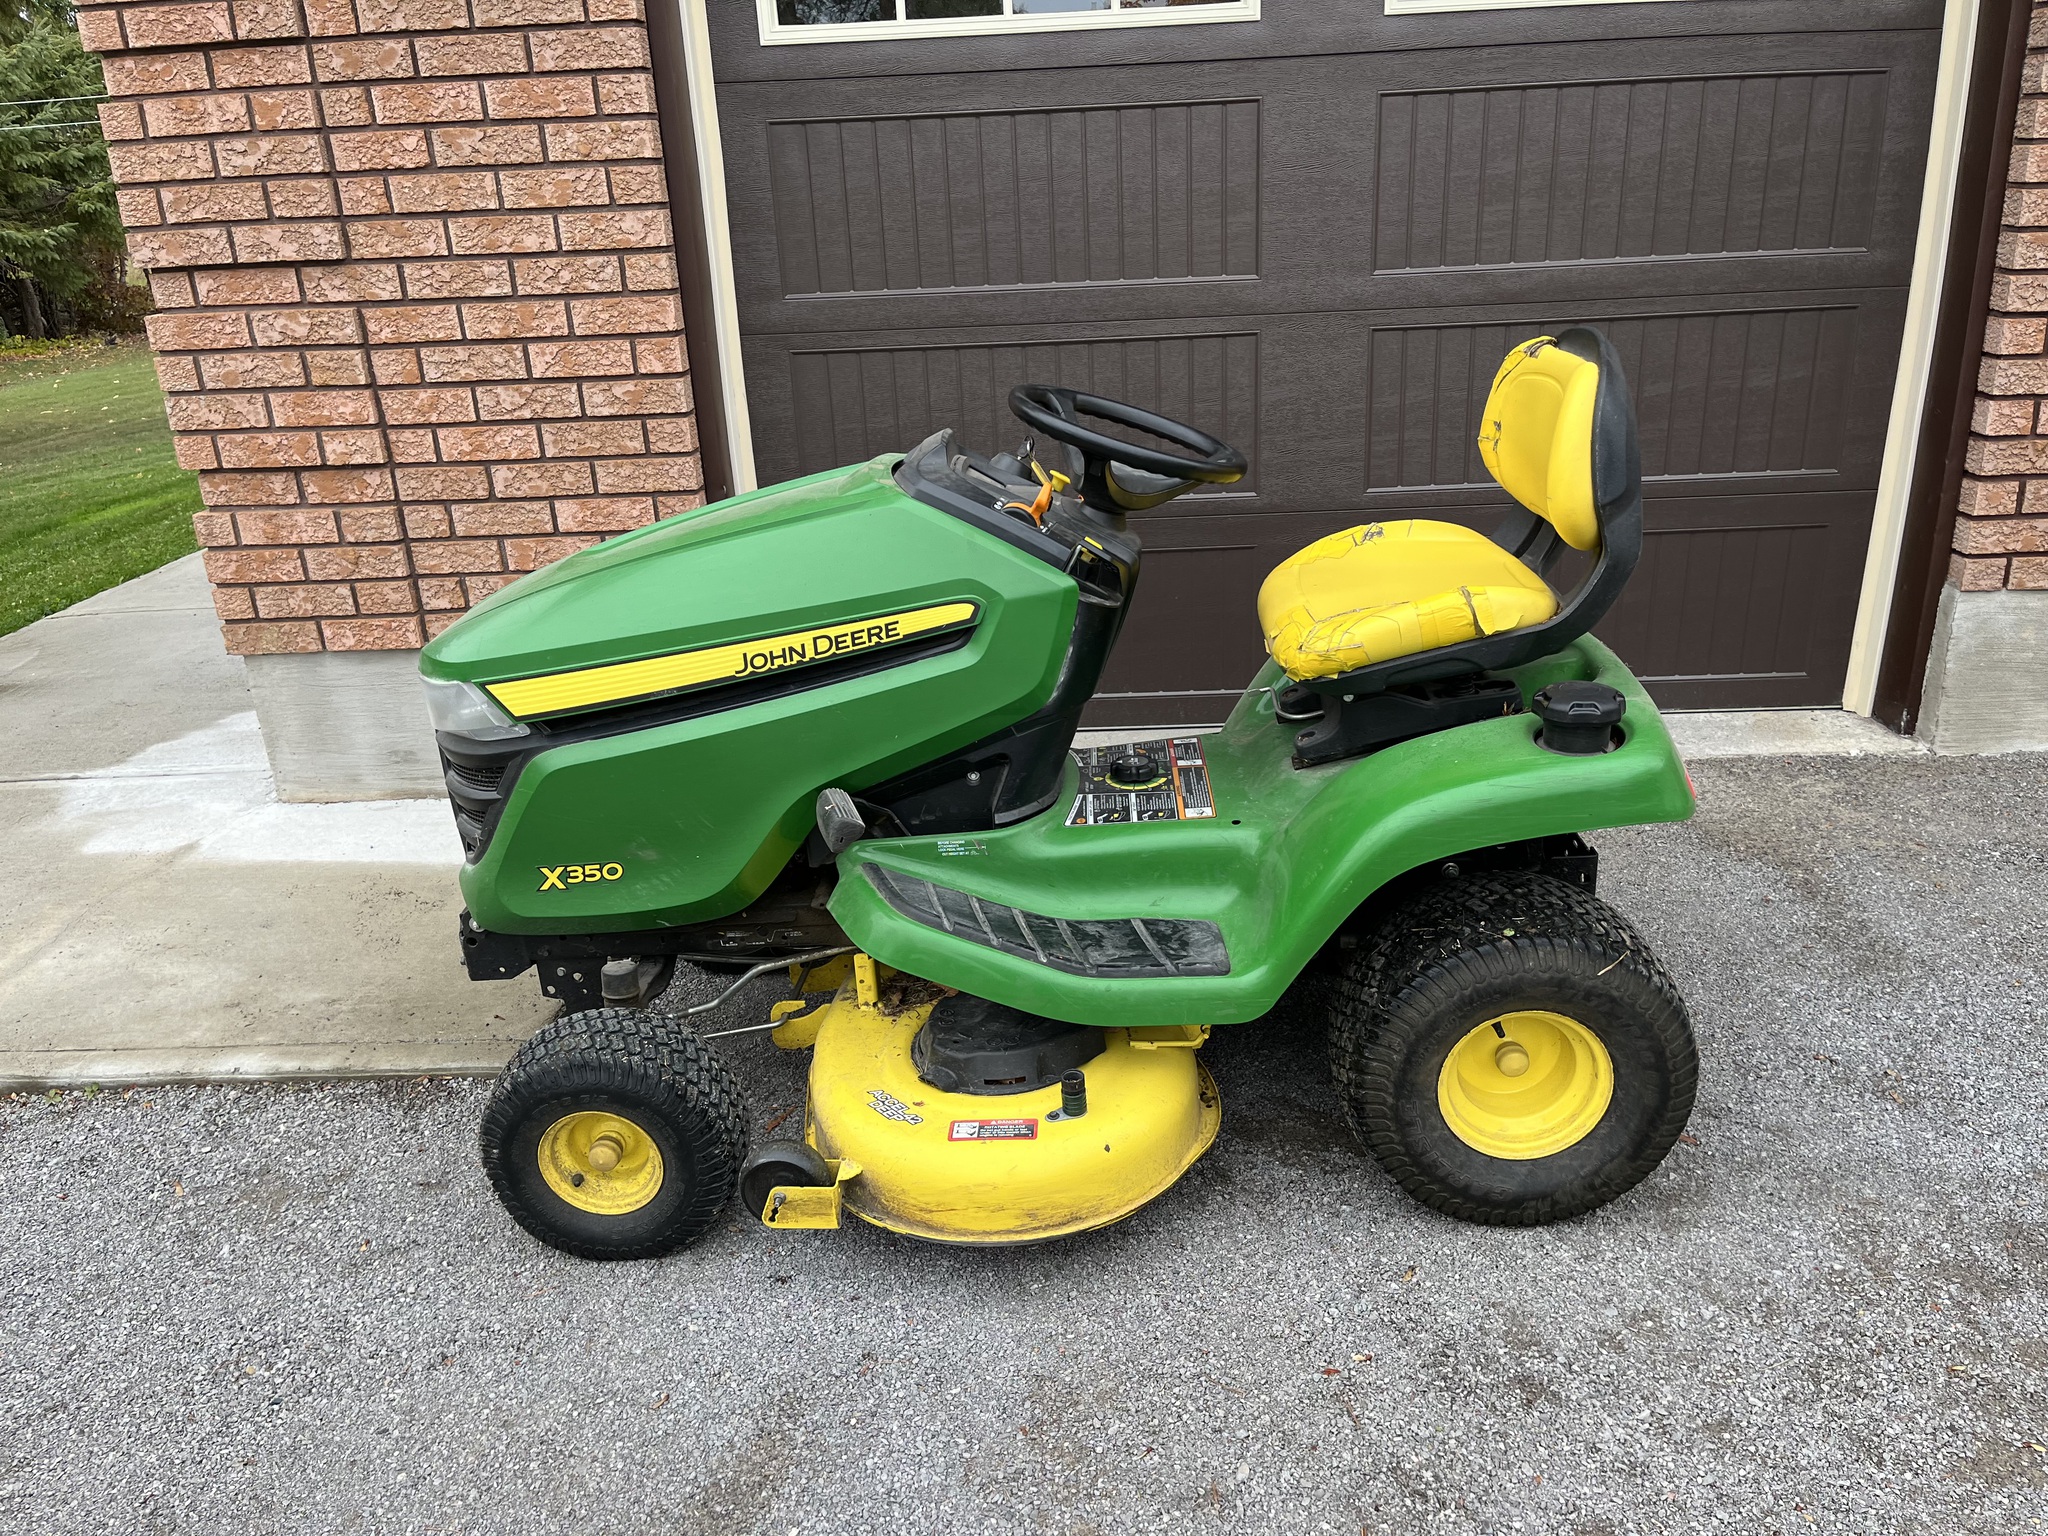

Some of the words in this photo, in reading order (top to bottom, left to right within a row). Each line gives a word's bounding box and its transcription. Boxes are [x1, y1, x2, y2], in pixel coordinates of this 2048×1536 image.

[735, 643, 806, 675] JOHN
[812, 622, 901, 657] DEERE
[537, 861, 624, 891] X350
[867, 1089, 910, 1116] ACCEL
[867, 1101, 905, 1121] DEEP
[901, 1113, 924, 1125] 42
